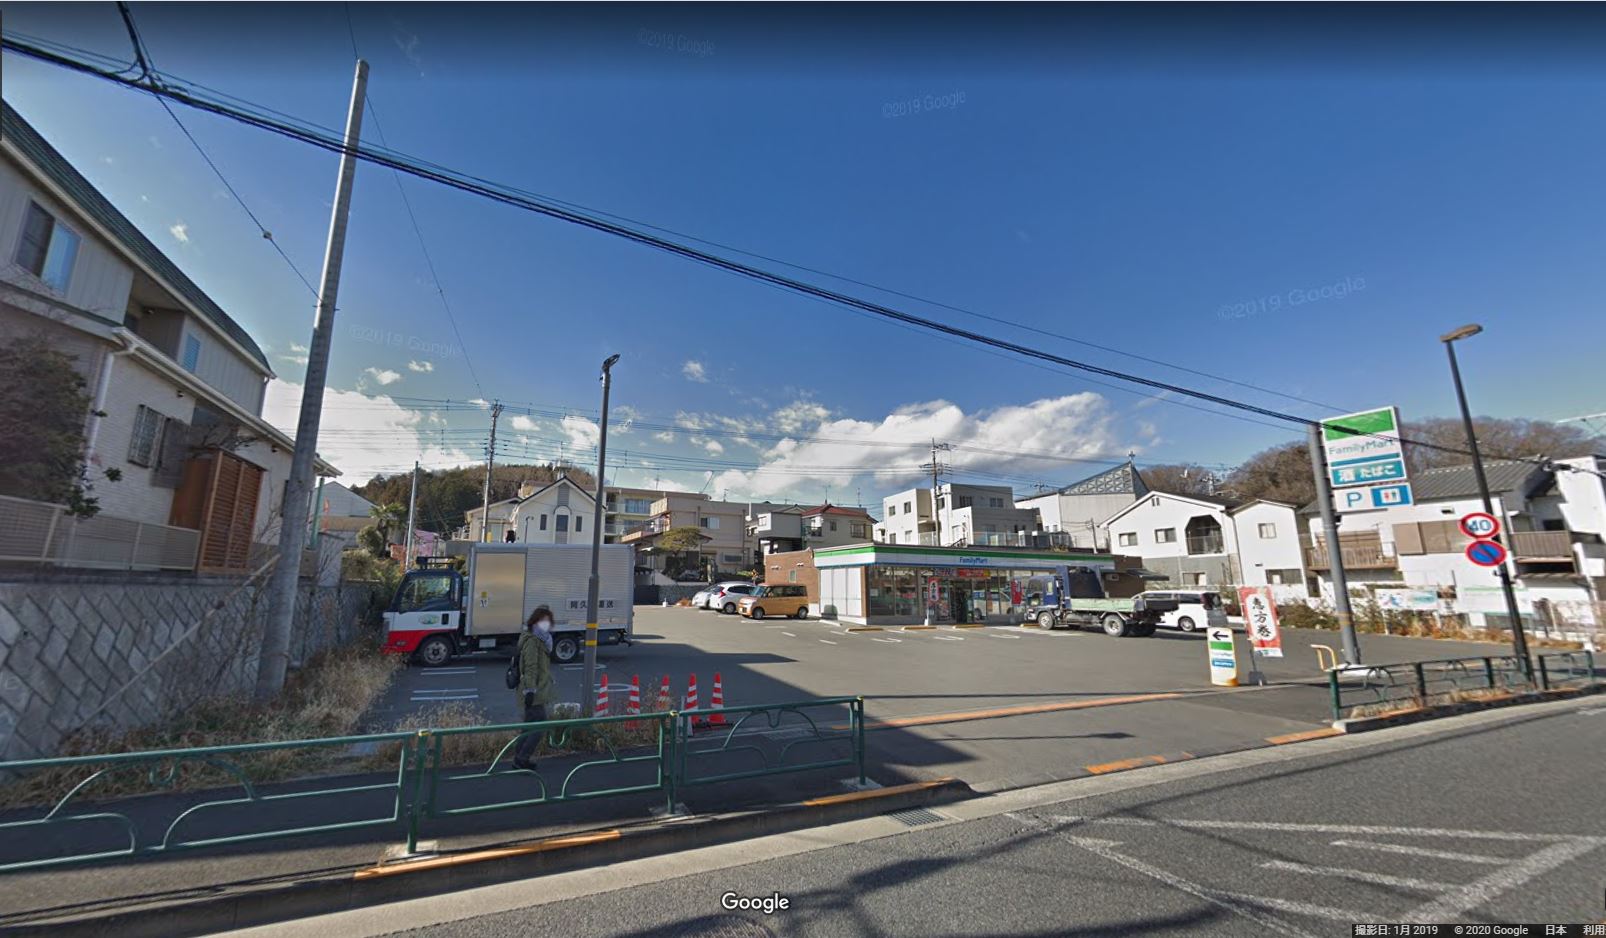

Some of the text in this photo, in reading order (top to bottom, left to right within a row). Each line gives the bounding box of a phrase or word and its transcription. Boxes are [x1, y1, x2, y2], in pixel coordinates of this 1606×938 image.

[1360, 464, 1396, 479] たばこ
[1346, 492, 1362, 507] P
[1467, 519, 1492, 531] 40
